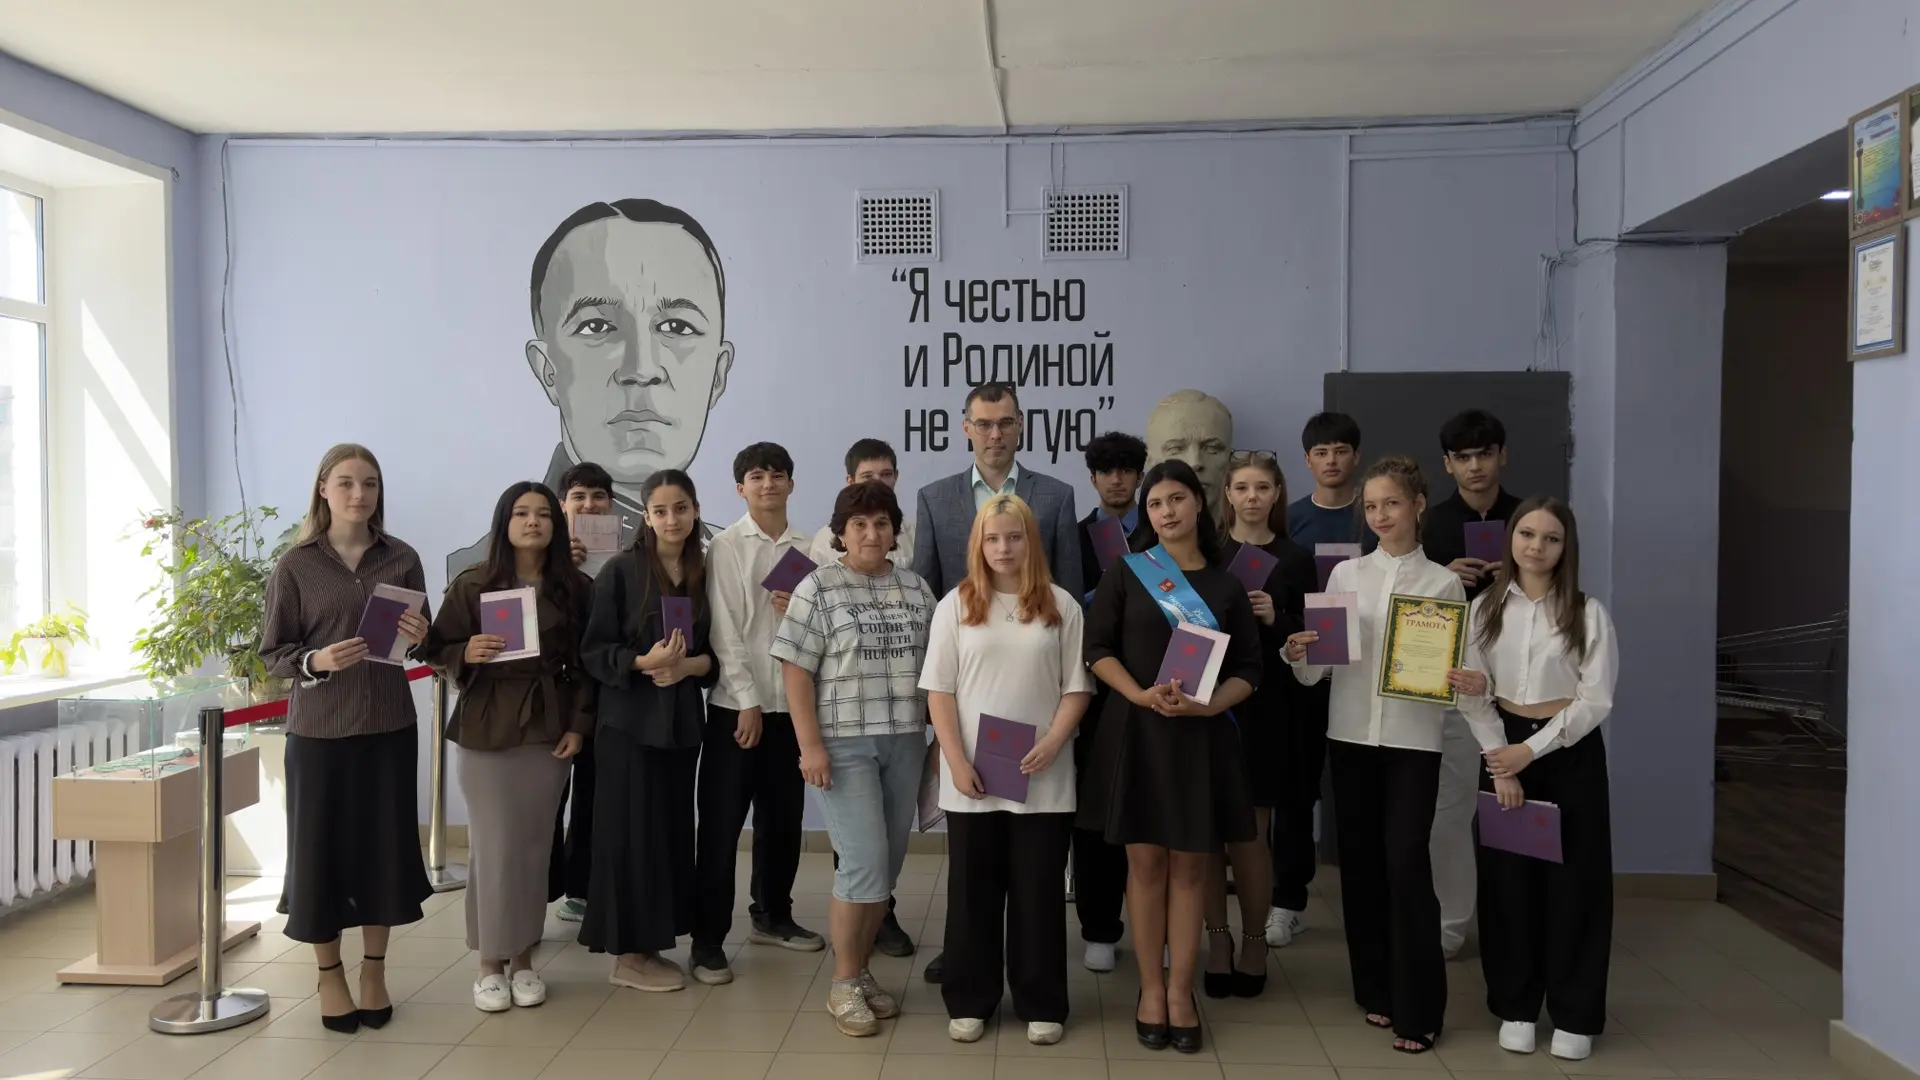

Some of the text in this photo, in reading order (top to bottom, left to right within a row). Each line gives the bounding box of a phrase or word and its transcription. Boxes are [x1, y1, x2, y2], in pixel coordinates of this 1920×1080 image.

[944, 278, 1086, 323] честью
[904, 330, 1114, 393] и Родиной
[904, 395, 1115, 464] не гую”
[868, 611, 908, 621] CLOSEST
[859, 622, 904, 634] COLOR
[1406, 619, 1447, 630] ГРАМОТА
[876, 634, 911, 646] TRUTH
[863, 647, 888, 660] HUE
[891, 647, 905, 659] OF
